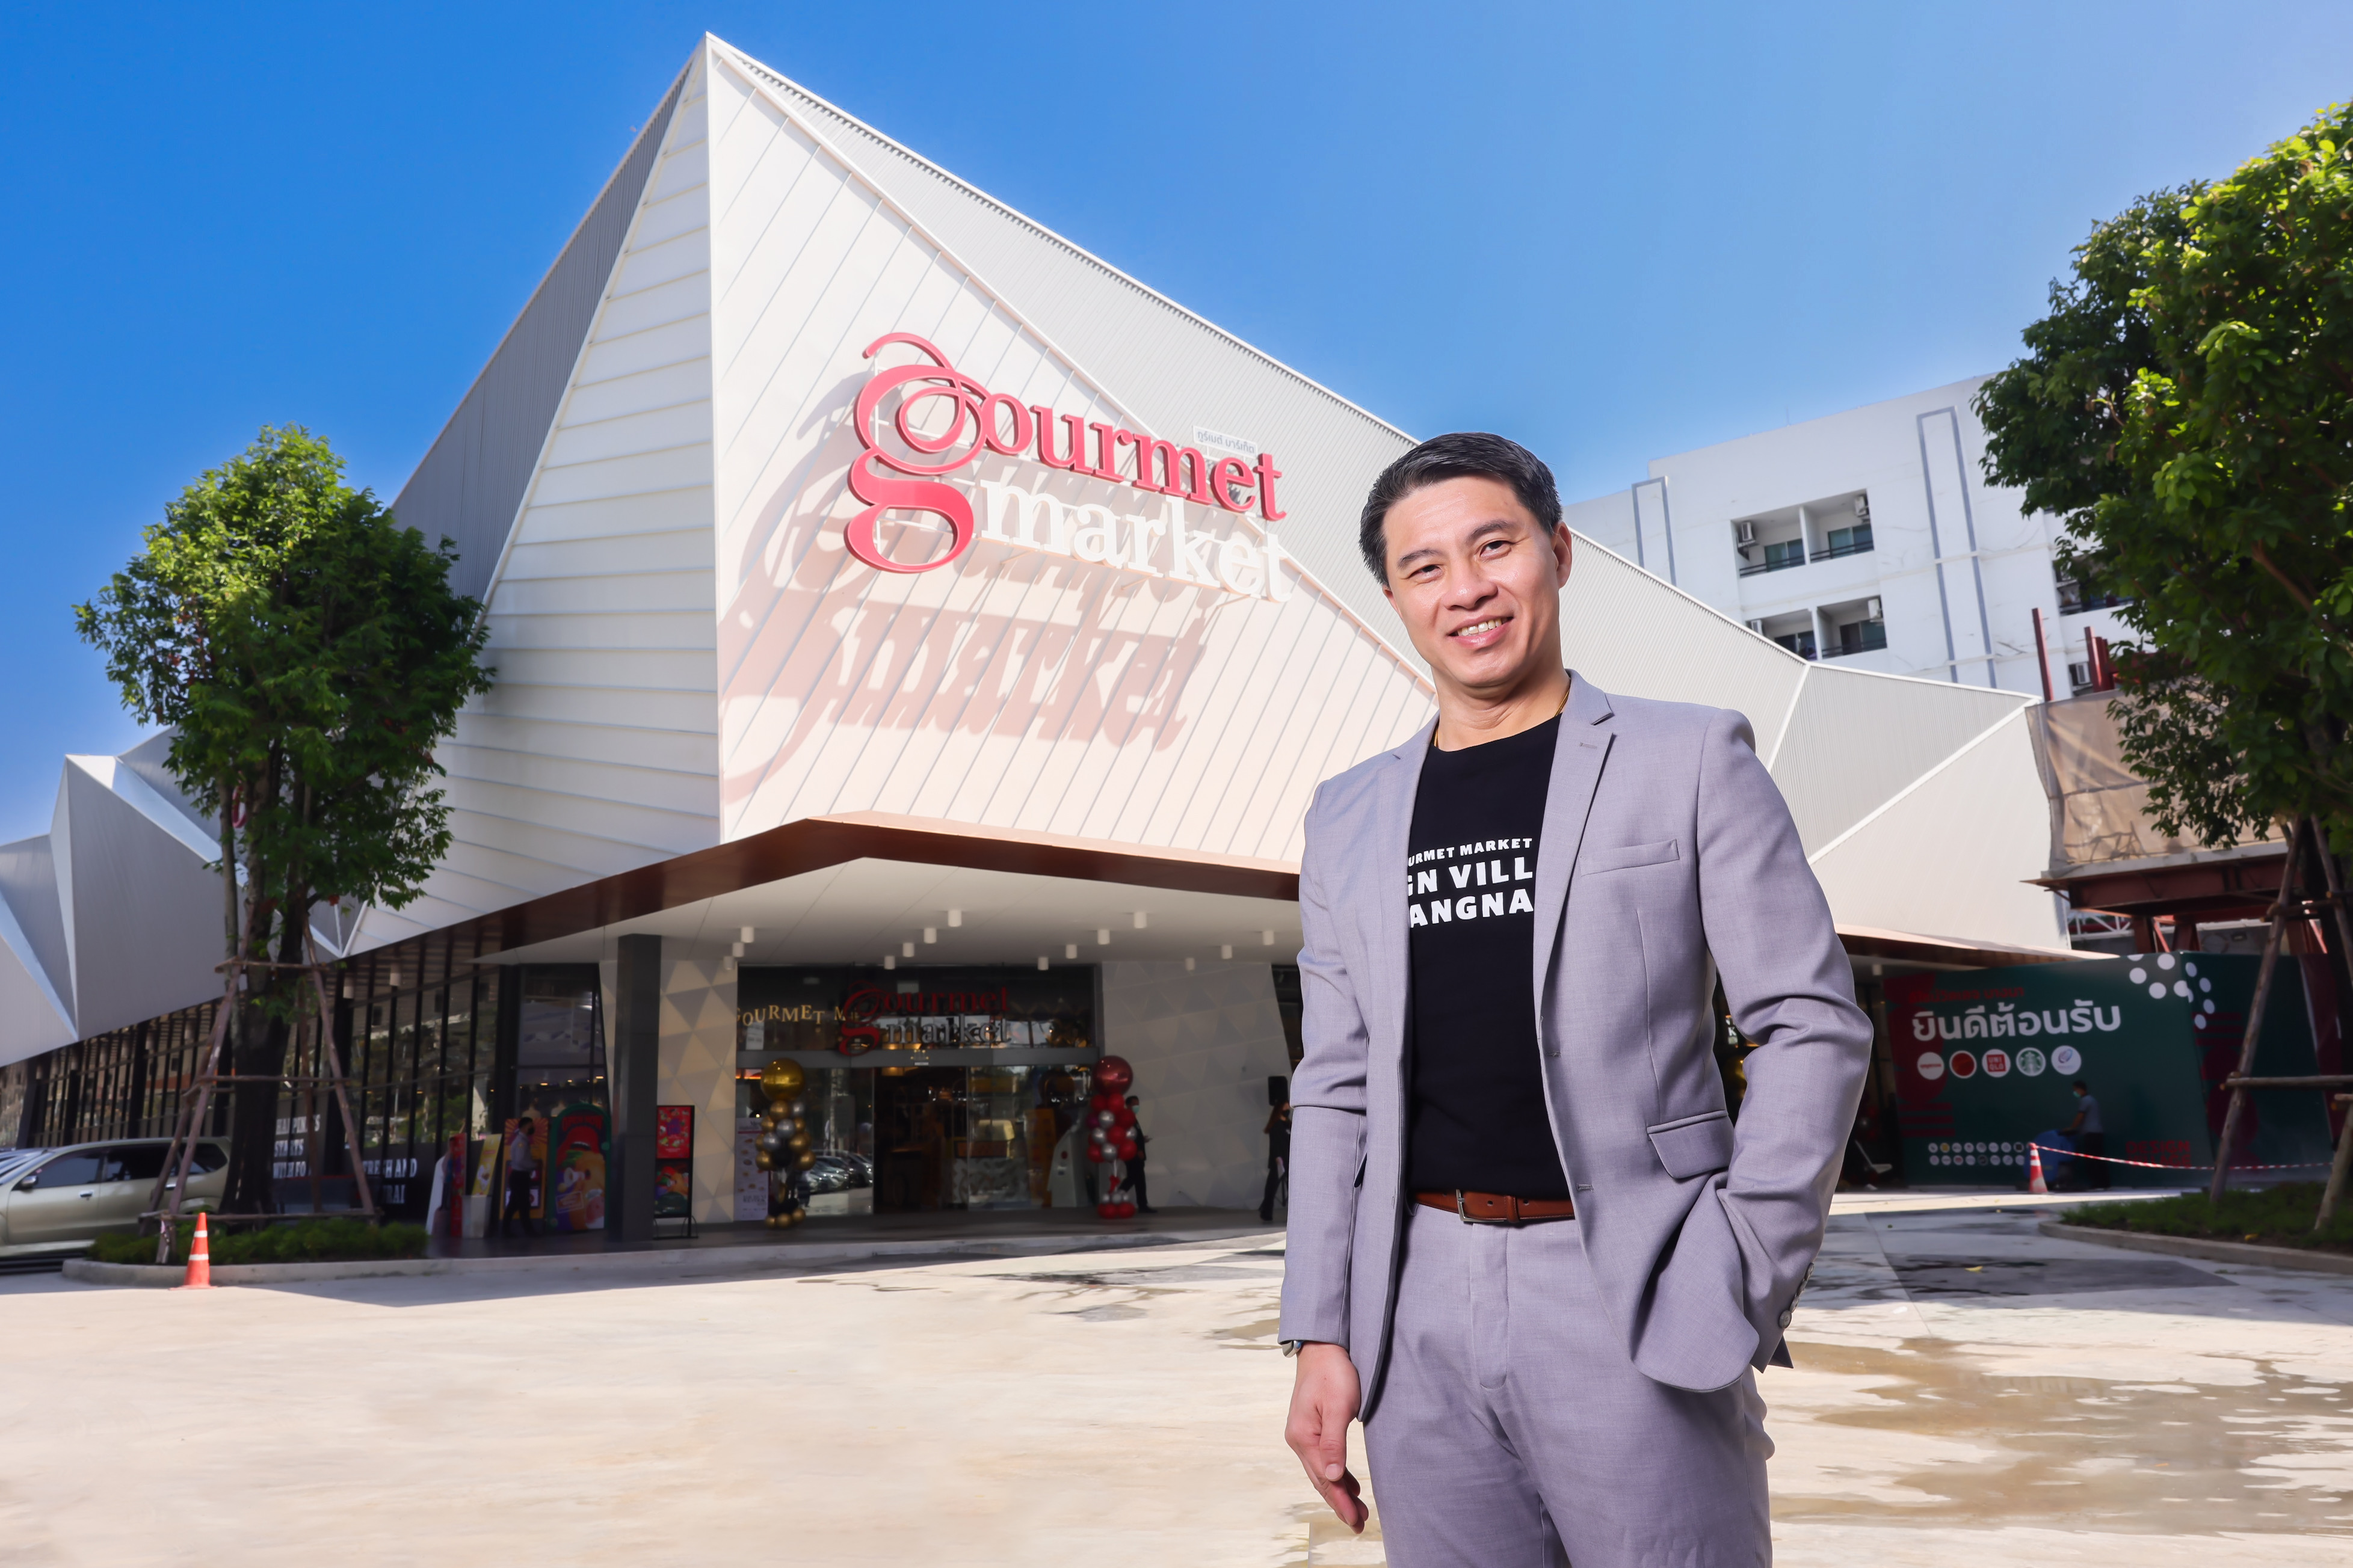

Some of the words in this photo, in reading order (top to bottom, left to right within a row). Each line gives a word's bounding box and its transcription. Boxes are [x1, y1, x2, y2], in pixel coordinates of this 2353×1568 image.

[973, 479, 1295, 603] market
[1460, 838, 1532, 856] MARKET
[1408, 869, 1438, 897] N
[1448, 856, 1533, 889] VILL
[1410, 888, 1534, 928] ANGNA
[887, 1013, 1012, 1045] market
[1912, 998, 2121, 1041] ยินดีต้อนรับ
[2125, 1140, 2191, 1154] DESIGN
